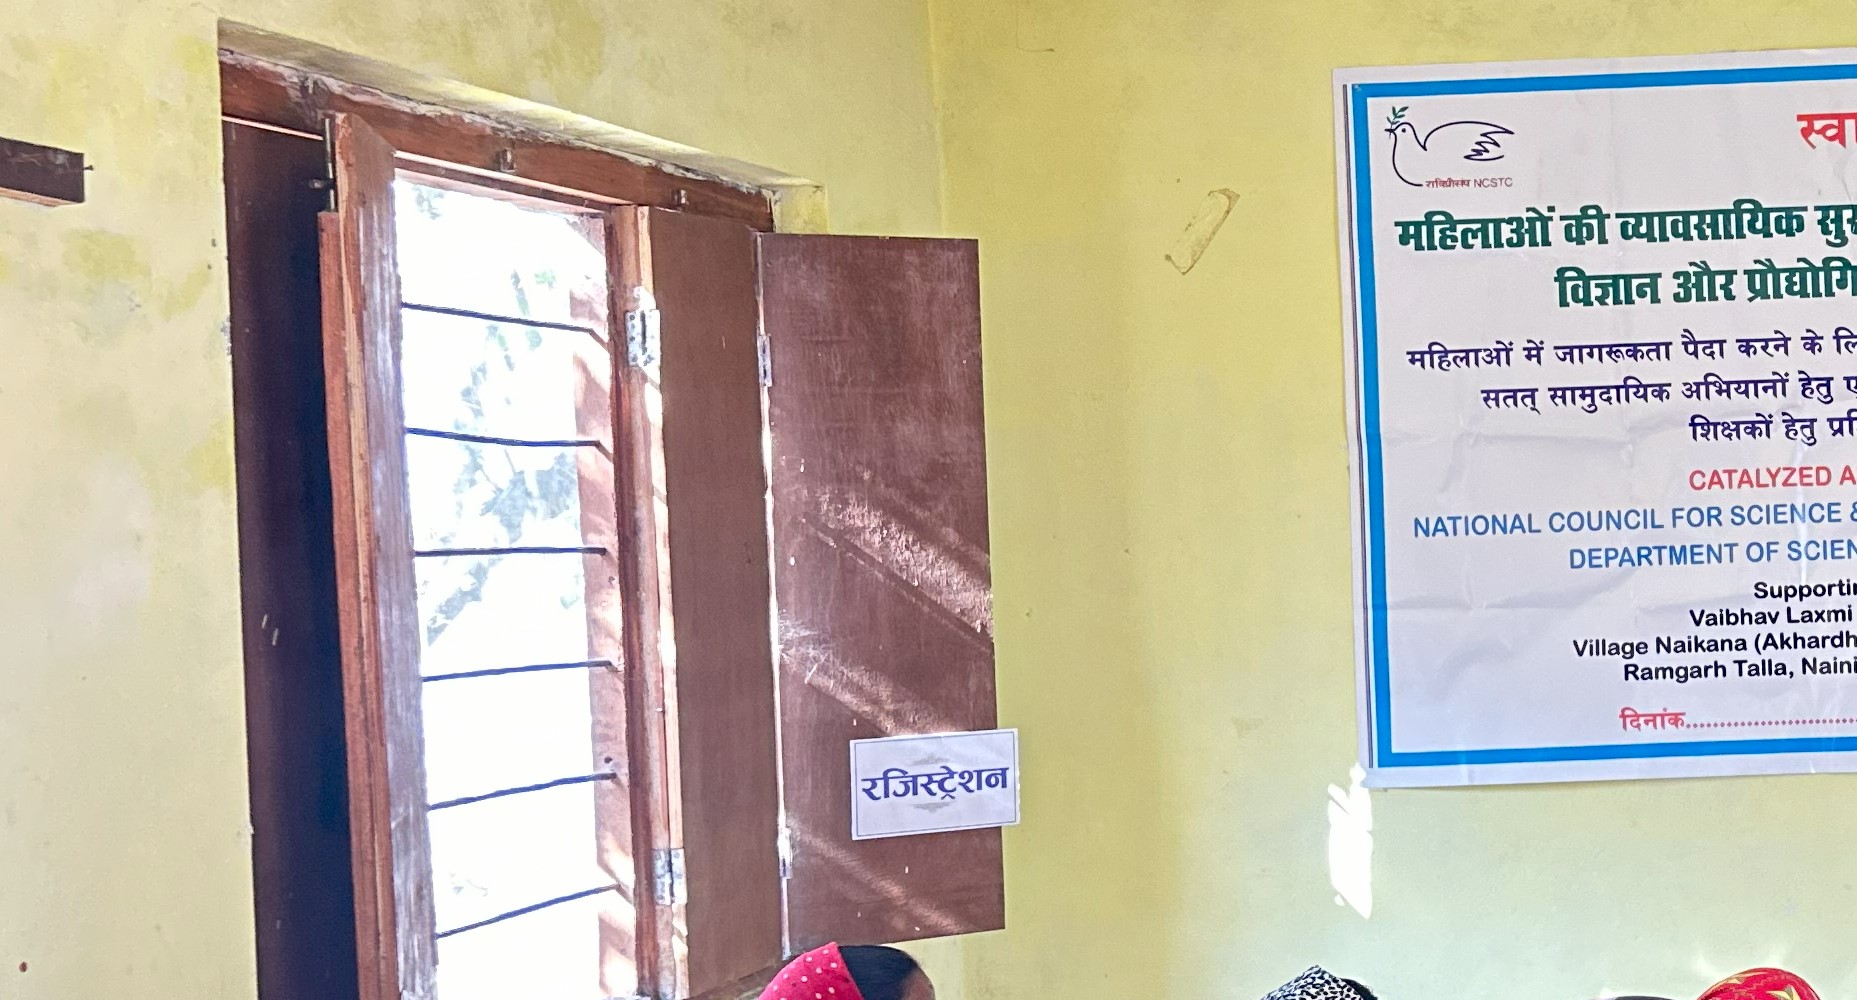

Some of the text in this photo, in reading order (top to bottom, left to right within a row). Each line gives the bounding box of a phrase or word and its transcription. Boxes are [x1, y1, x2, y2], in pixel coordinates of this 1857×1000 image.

[1473, 177, 1513, 188] NCSTC
[1395, 205, 1556, 251] महिलाओं
[1560, 204, 1610, 246] की
[1615, 199, 1808, 244] व्यावसायिक
[1555, 267, 1662, 308] विज्ञान
[1672, 260, 1738, 304] और
[1406, 340, 1513, 371] महिलाओं
[1522, 338, 1546, 367] में
[1554, 339, 1673, 366] जागरूकता
[1681, 328, 1727, 361] पैदा
[1738, 330, 1792, 358] करने
[1800, 330, 1823, 356] के
[1480, 388, 1541, 414] सतत्
[1548, 376, 1672, 414] सामुदायिक
[1681, 371, 1789, 401] अभियानों
[1799, 370, 1835, 405] हेतु
[1689, 412, 1774, 444] शिक्षकों
[1783, 412, 1818, 447] हेतु
[1689, 466, 1832, 492] CATALYZED
[1413, 513, 1541, 539] NATIONAL
[1548, 509, 1665, 534] COUNCIL
[1672, 507, 1724, 530] FOR
[1730, 501, 1844, 527] SCIENCE
[1570, 543, 1740, 570] DEPARTMENT
[1746, 541, 1781, 564] OF
[1690, 607, 1780, 628] Vaibhav
[1787, 605, 1854, 625] Laxmi
[1573, 637, 1649, 661] Village
[1656, 634, 1748, 655] Naikana
[1623, 660, 1728, 684] Ramgarh
[1733, 657, 1794, 680] Talla,
[861, 765, 1009, 801] रजिस्ट्रेशन
